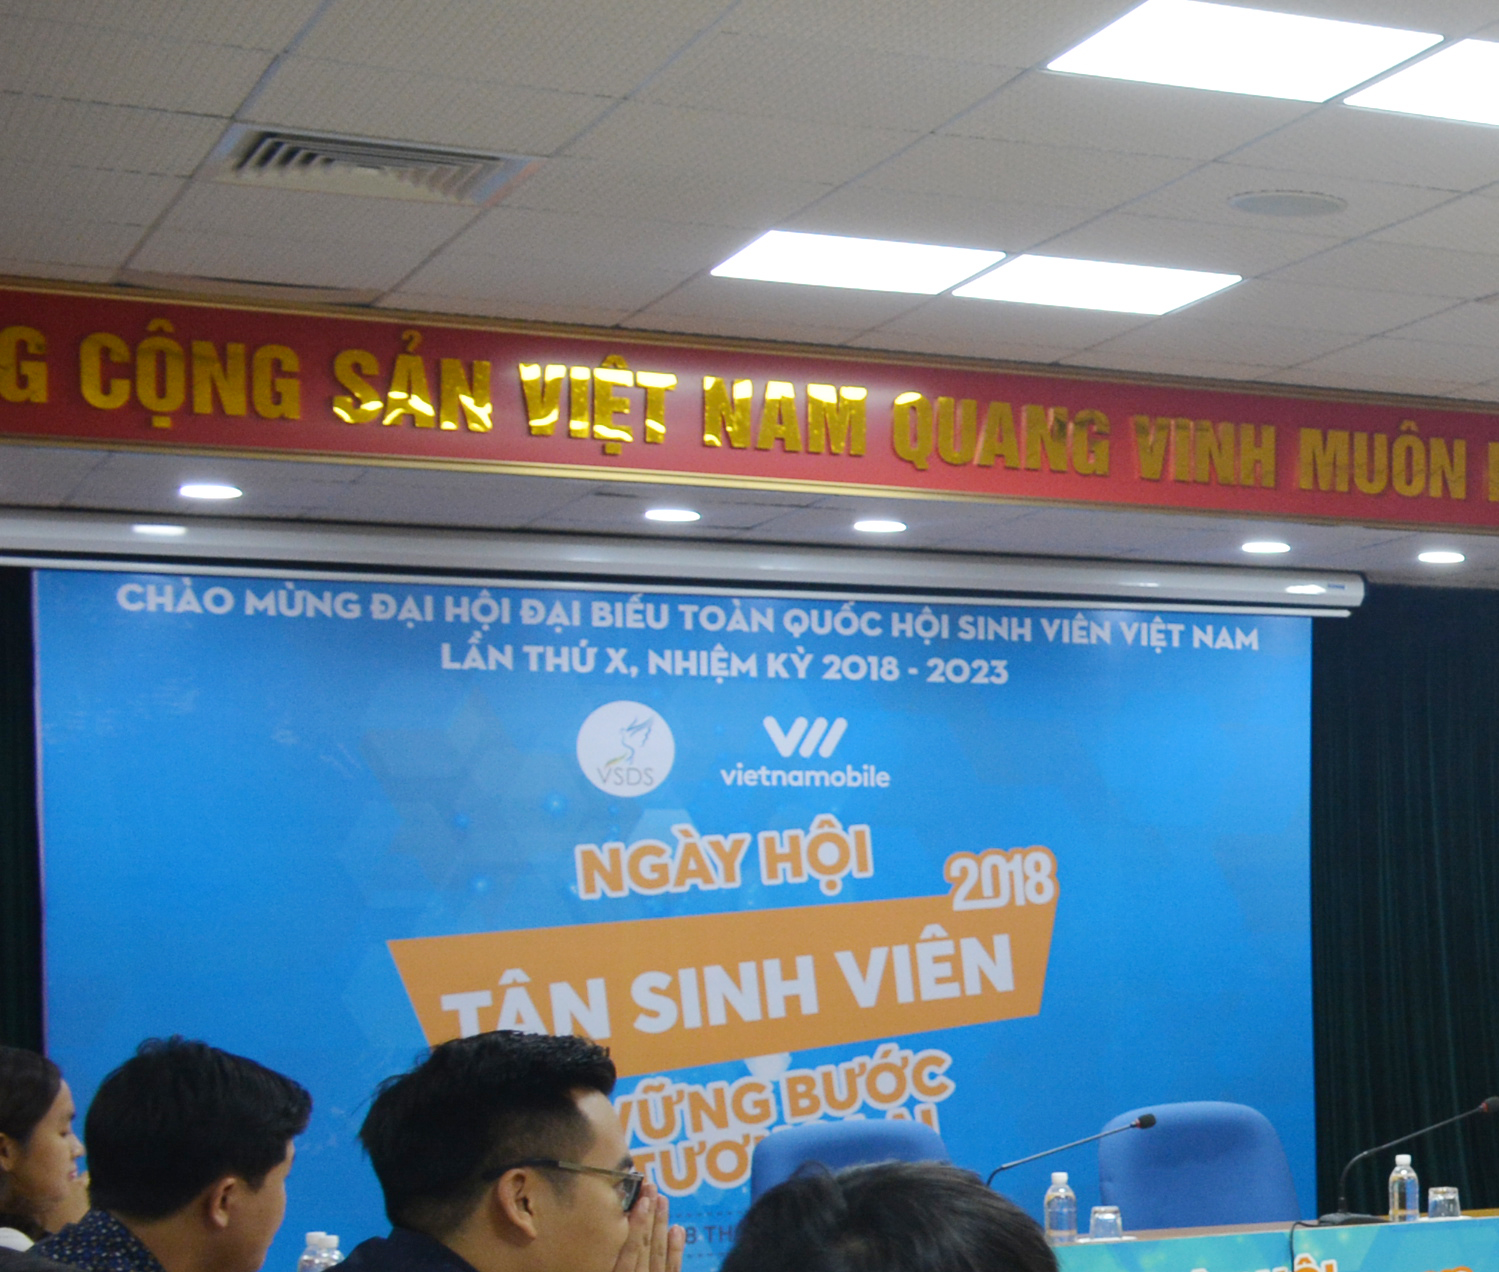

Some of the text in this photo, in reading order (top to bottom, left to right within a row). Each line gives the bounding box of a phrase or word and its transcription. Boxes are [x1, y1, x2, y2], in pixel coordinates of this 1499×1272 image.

[79, 319, 301, 428] CỘNG
[333, 330, 492, 432] SẢN
[519, 355, 677, 455] VIỆT
[703, 376, 867, 456] NAM
[892, 391, 1110, 477] QUANG
[1133, 415, 1277, 488] VINH
[1299, 425, 1466, 501] MUÔN
[116, 579, 1259, 654] CHÀO MỪNG ĐẠI HỘI ĐẠI BIỂU TOÀN QUỐC HỘI SINH VIÊN VIỆT NAM
[441, 630, 513, 672] LẦN
[523, 640, 598, 673] THỨ
[605, 647, 639, 678] X,
[649, 644, 757, 683] NHIỆM
[767, 647, 813, 680] KỲ
[822, 655, 900, 681] 2018
[926, 658, 1009, 685] 2023
[596, 766, 654, 788] VSDS
[720, 761, 891, 788] vietnamobile
[578, 818, 872, 897] NGÀY HỘI
[948, 849, 1055, 912] 2018
[441, 925, 1014, 1040] TÂN SINH VIÊN
[784, 1046, 952, 1120] BƯỚC
